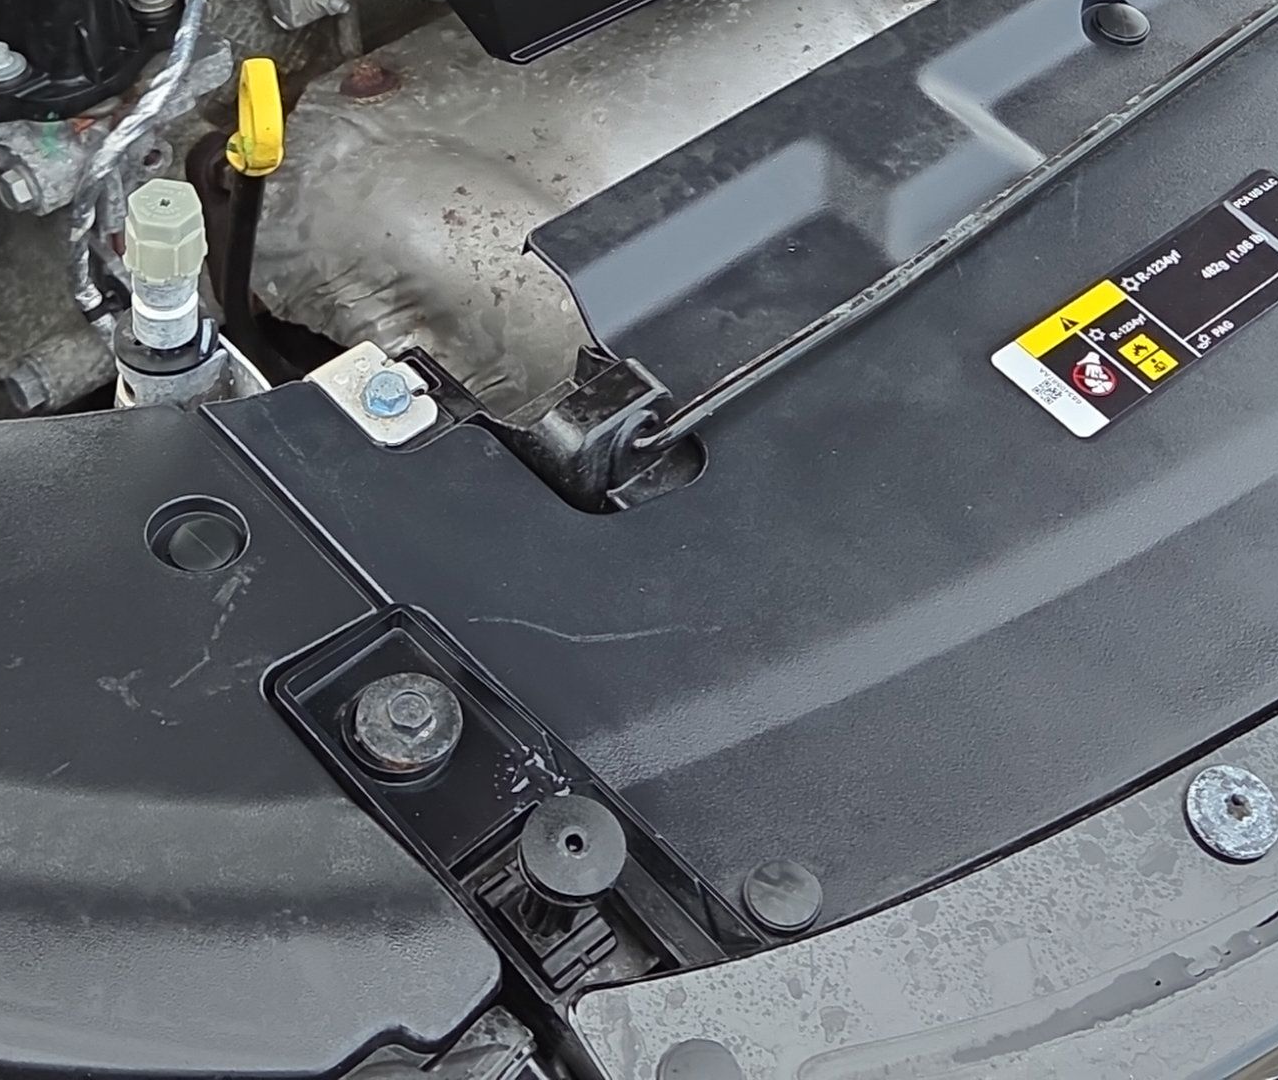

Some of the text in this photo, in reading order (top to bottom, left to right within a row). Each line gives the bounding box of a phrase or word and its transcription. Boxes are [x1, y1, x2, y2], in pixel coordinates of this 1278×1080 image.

[1233, 177, 1278, 209] FCA US LLC
[1135, 248, 1182, 283] R-1234yf
[1201, 259, 1231, 279] 482g
[1225, 240, 1254, 263] (1.06
[1109, 312, 1147, 341] R-1234yf
[1210, 319, 1235, 338] PAG
